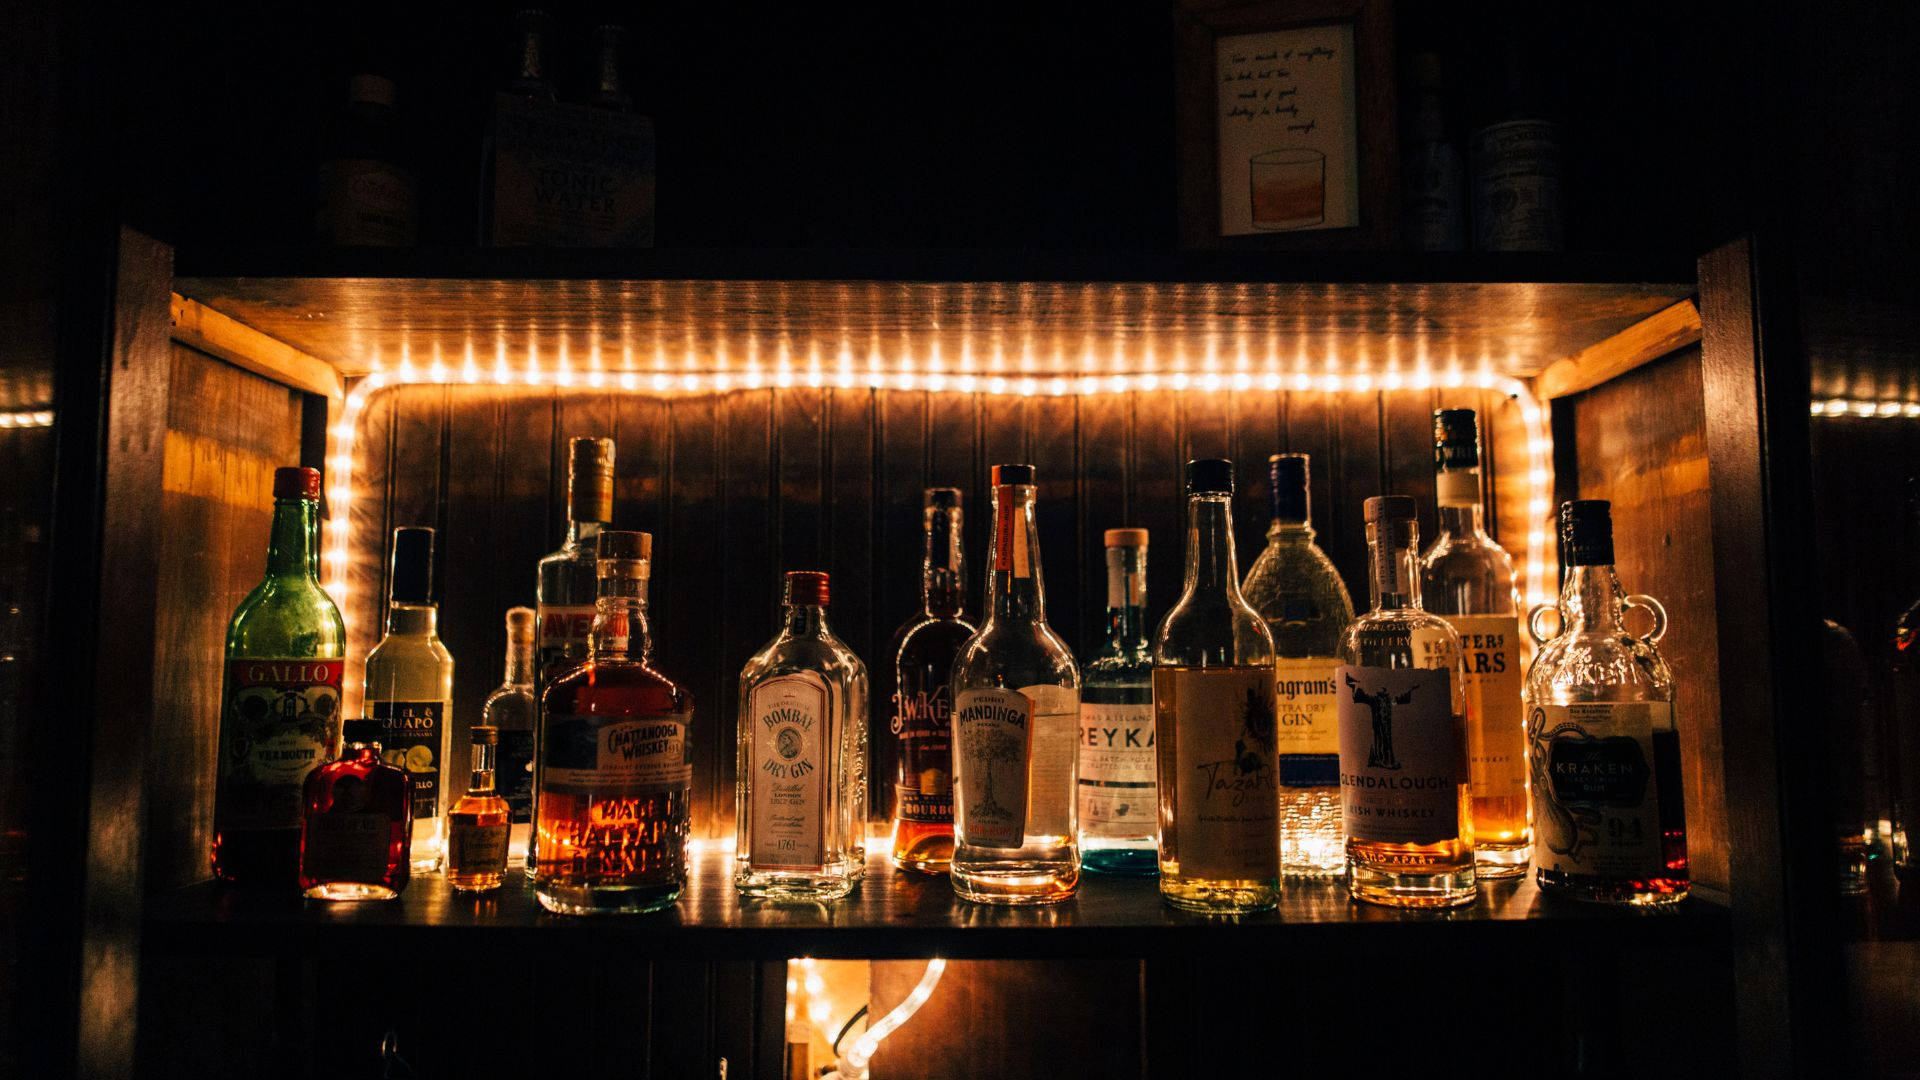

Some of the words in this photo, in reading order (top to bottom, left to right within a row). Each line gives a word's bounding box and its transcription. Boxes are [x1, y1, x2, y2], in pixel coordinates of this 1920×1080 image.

[537, 168, 618, 194] TONIC
[535, 187, 616, 214] WATER
[249, 664, 329, 683] GALLO
[1276, 677, 1337, 701] agram's
[402, 708, 415, 718] EL
[1276, 703, 1302, 713] TRA
[1306, 703, 1328, 713] DRY
[763, 708, 817, 732] BOMBAY
[959, 705, 1027, 730] MANDINGA
[1282, 713, 1313, 727] GIN
[608, 724, 678, 754] CHATTANOOGA
[256, 749, 315, 761] VERMOUTH
[622, 739, 669, 761] WHISKEY
[763, 759, 788, 778] DRY
[791, 758, 814, 779] GIN
[1555, 761, 1633, 775] KRAKEN
[415, 781, 434, 789] ELLO
[1341, 773, 1449, 790] GLENDALOUGH
[905, 803, 954, 815] BOURBO
[1376, 807, 1436, 819] WHISKEY
[778, 839, 796, 851] 1761
